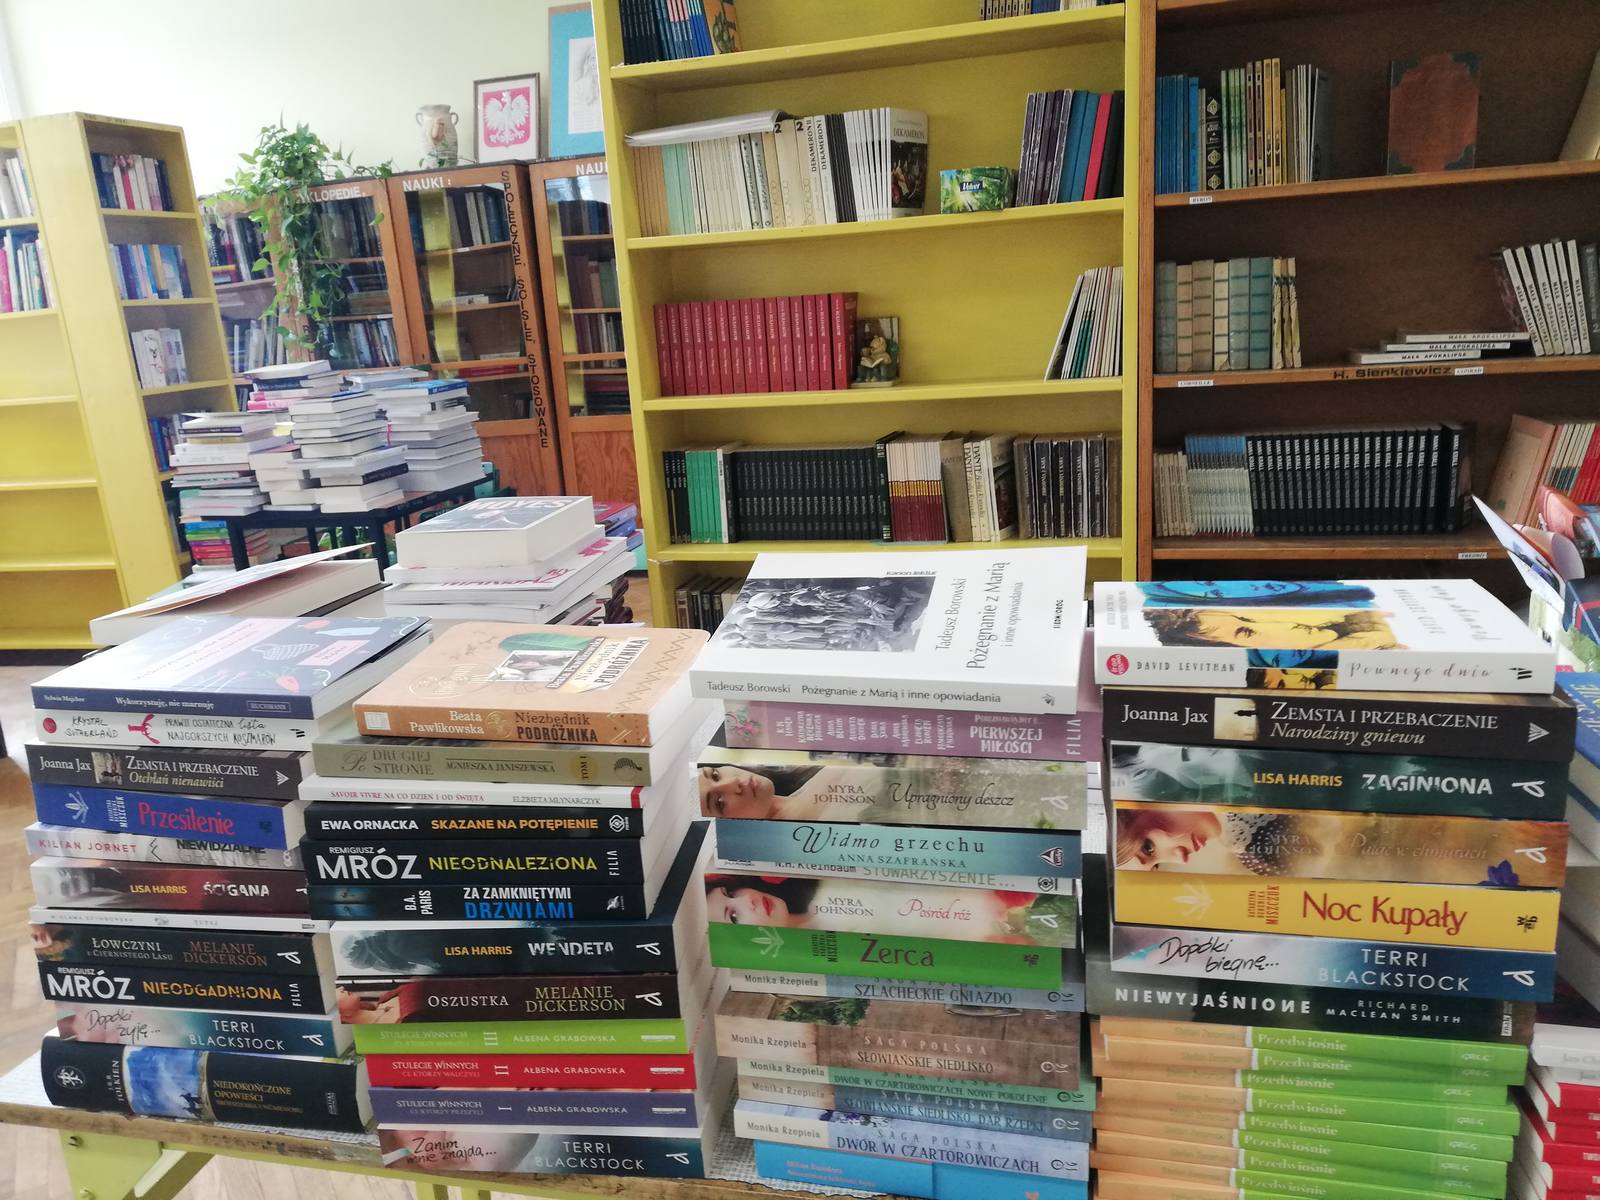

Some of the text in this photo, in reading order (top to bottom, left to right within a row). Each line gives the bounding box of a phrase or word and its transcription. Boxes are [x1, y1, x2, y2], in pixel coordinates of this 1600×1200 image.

[774, 124, 781, 133] 2
[796, 122, 803, 131] 2
[894, 128, 925, 139] DEKAMERON
[807, 126, 817, 172] DEKAMERON
[816, 125, 826, 170] DEKAMERON
[403, 177, 443, 191] NAUKI
[1355, 365, 1452, 378] Sienkiewicz
[528, 354, 547, 447] STOSOWANE
[945, 578, 967, 615] Borowski
[966, 561, 1011, 668] Pożegnanie Marią
[1137, 662, 1236, 671] DAVID LEVITHAN
[706, 681, 791, 694] Tadeusz Borowski
[801, 684, 1001, 704] Pożegnanie Marią inne opowiadania
[72, 716, 107, 726] KRYSTAL
[449, 710, 482, 723] Beata
[1121, 705, 1209, 724] Joanna Jax
[1270, 702, 1498, 729] ZEMSTA PRZEBACZENIE
[409, 721, 485, 735] Pawlikowska
[517, 723, 599, 743] PODRÓŻNIKA
[969, 726, 1043, 742] PIERWSZEJ
[1270, 723, 1425, 746] Narodziny gniewu
[1066, 719, 1082, 755] FILIA
[979, 738, 1033, 754] MIŁOŚCI
[39, 756, 92, 772] Joanna Jax
[126, 756, 259, 777] ZEMSTA PRZEBACZENIE
[1253, 772, 1343, 787] LISA HARRIS
[1362, 774, 1493, 795] ZAGINIONA
[827, 785, 865, 794] MYRA
[888, 782, 1015, 811] Upragniony deszcz
[814, 793, 876, 804] JOHNSON
[138, 800, 235, 835] Przesilenie
[321, 820, 418, 831] EWA ORNACKA
[431, 818, 598, 831] SKAZANE NA POTĘPIENIE
[38, 839, 136, 853] KILIAN JORNET
[792, 825, 985, 856] Widmo grzechu
[316, 847, 422, 879] MRÓZ
[428, 857, 598, 871] NIEODNALEZIONA
[607, 850, 618, 876] FILIA
[838, 853, 967, 868] ANNA SZAFRAŃSKA
[130, 885, 187, 894] LISA HARRIS
[203, 881, 269, 897] ŚCIGANA
[463, 887, 571, 902] ZA ZAMKNIĘTYMI
[405, 894, 416, 912] B.A.
[420, 889, 432, 915] PARIS
[464, 901, 575, 919] DRZWIAMI
[827, 897, 863, 907] MYRA
[897, 898, 950, 920] Pośród
[813, 905, 874, 917] JOHNSON
[1302, 890, 1467, 936] Noc Kupały
[92, 938, 161, 952] ŁOWCZYNI
[189, 942, 256, 954] MELANIE
[445, 945, 513, 956] LISA HARRIS
[1158, 936, 1233, 965] Dopóki
[1361, 948, 1427, 967] TERRI
[47, 970, 136, 1000] MRÓZ
[744, 975, 819, 987] Monika Rzepiela
[1318, 967, 1469, 992] BLACKSTOCK
[143, 981, 283, 1001] NIEODGADNIONA
[535, 985, 613, 1000] MELANIE
[854, 986, 1013, 1005] SZLACHECKIE GNIAZDO
[428, 995, 509, 1008] OSZUSTKA
[526, 998, 625, 1013] DICKERSON
[1357, 1000, 1430, 1012] RICHARD
[1325, 1008, 1462, 1024] MACLEAN SMITH
[212, 1020, 255, 1033] TERRI
[190, 1034, 285, 1051] BLACKSTOCK
[554, 1035, 616, 1043] GRABOWSKA
[731, 1033, 807, 1048] Monika Rzepiela
[864, 1035, 988, 1055] SAGA POLSKA
[1258, 1034, 1347, 1051] Przedwiośnie
[392, 1061, 479, 1070] STULECIE WINNYCH
[523, 1066, 560, 1074] AŁBENA
[750, 1061, 825, 1076] Monika Rzepiela
[857, 1051, 994, 1074] SŁOWIAŃSKIE SIEDLISKO
[1264, 1056, 1353, 1071] Przedwiośnie
[1248, 1074, 1335, 1089] Przedwiośnie
[751, 1082, 825, 1098] Monika Rzepiela
[967, 1088, 993, 1099] NOWE
[396, 1100, 482, 1109] STULECIE WINNYCH
[566, 1106, 628, 1114] GRABOWSKA
[1258, 1099, 1346, 1115] Przedwiośnie
[747, 1122, 821, 1138] Monika Rzepiela
[1251, 1118, 1338, 1135] Przedwiośnie
[411, 1137, 458, 1154] Zanim
[562, 1141, 612, 1154] TERRI
[1244, 1135, 1331, 1155] Przedwiośnie
[836, 1136, 1040, 1173] DWÓR W CZARTOROWICZACH
[535, 1156, 646, 1170] BLACKSTOCK
[1250, 1157, 1337, 1174] Przedwiośnie
